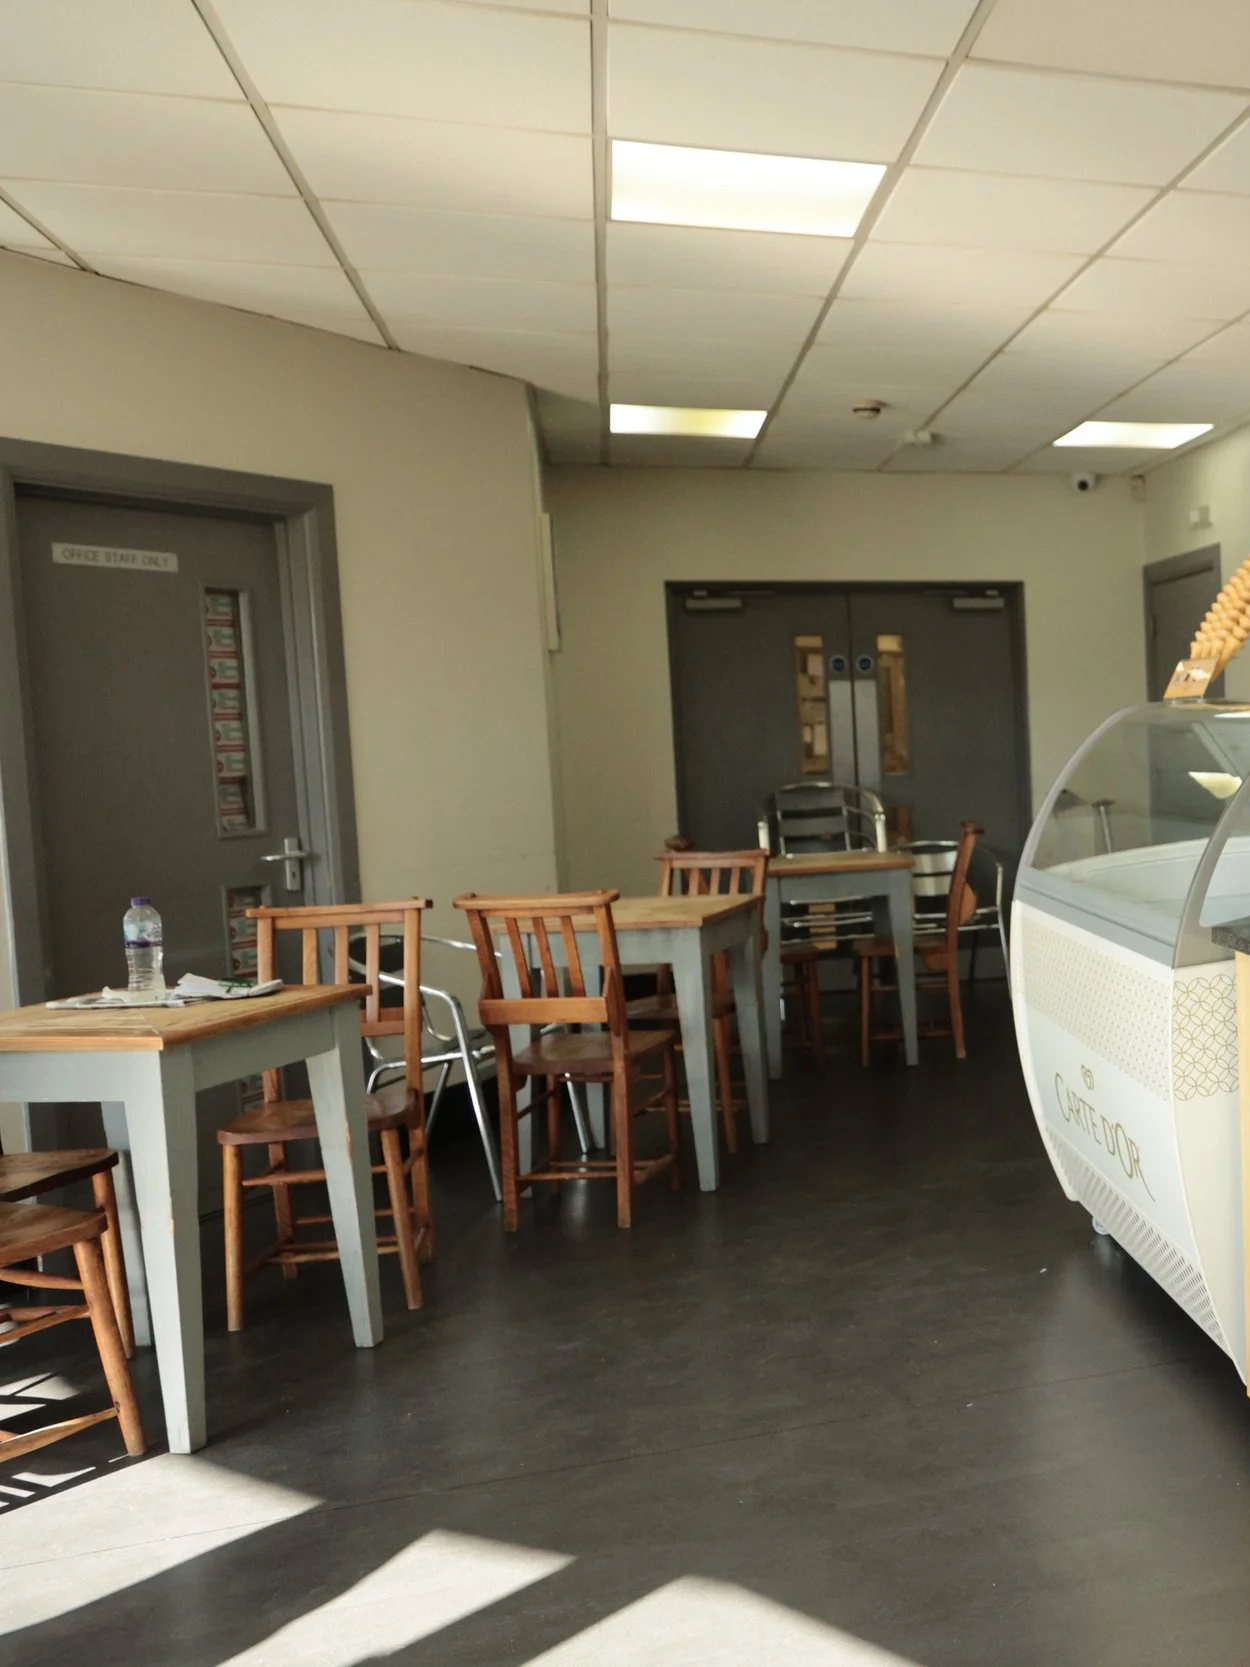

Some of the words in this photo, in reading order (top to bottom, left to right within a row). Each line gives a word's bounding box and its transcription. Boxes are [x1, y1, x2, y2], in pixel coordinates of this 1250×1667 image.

[62, 547, 100, 560] OFFICE
[105, 552, 138, 564] STAFF
[142, 555, 168, 568] ONLY
